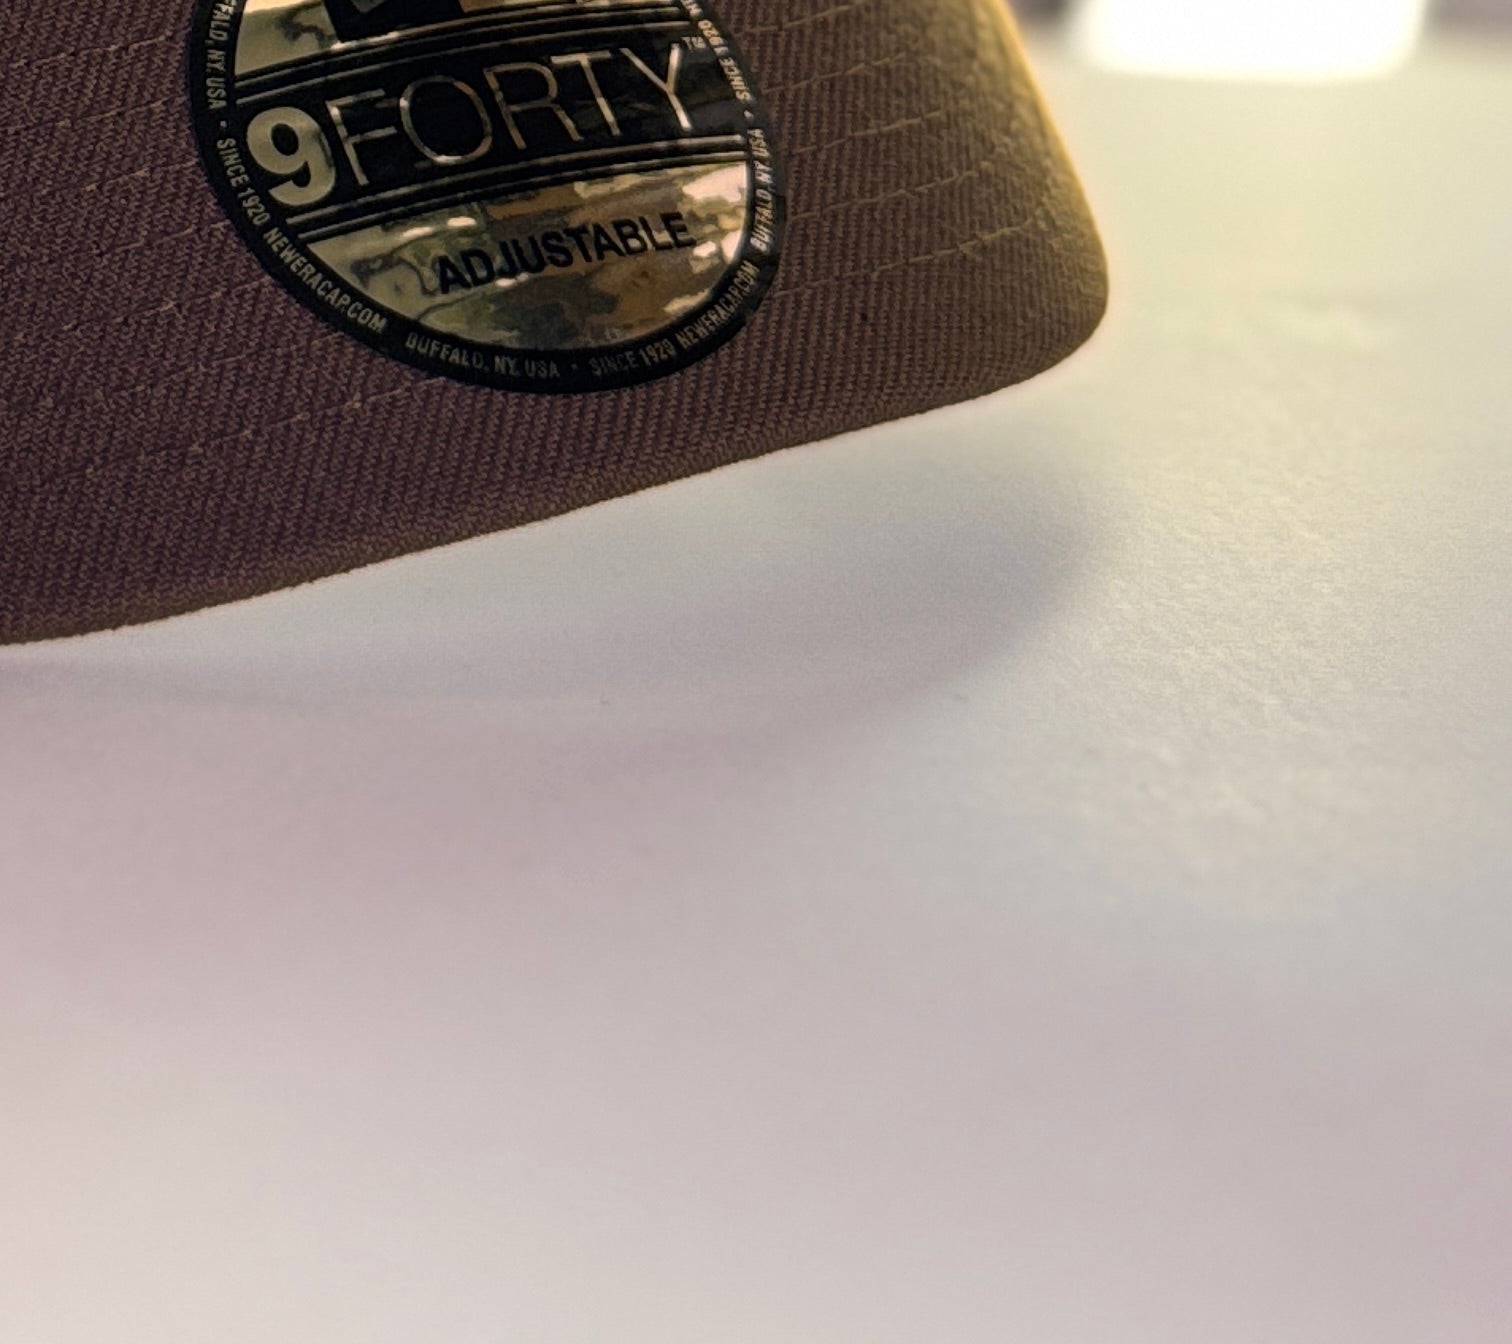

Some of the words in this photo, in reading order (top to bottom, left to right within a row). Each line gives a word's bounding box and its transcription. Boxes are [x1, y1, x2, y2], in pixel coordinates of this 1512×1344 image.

[206, 77, 228, 110] USA
[719, 56, 756, 102] SINCE
[246, 42, 693, 206] 9FORTY
[216, 137, 251, 188] SINCE
[238, 187, 271, 227] 1920
[436, 213, 697, 295] ADJUSTABLE
[262, 227, 388, 334] NEWERACAP.COM
[524, 359, 561, 379] USA
[589, 350, 639, 377] SINCE
[638, 338, 677, 368] 1920
